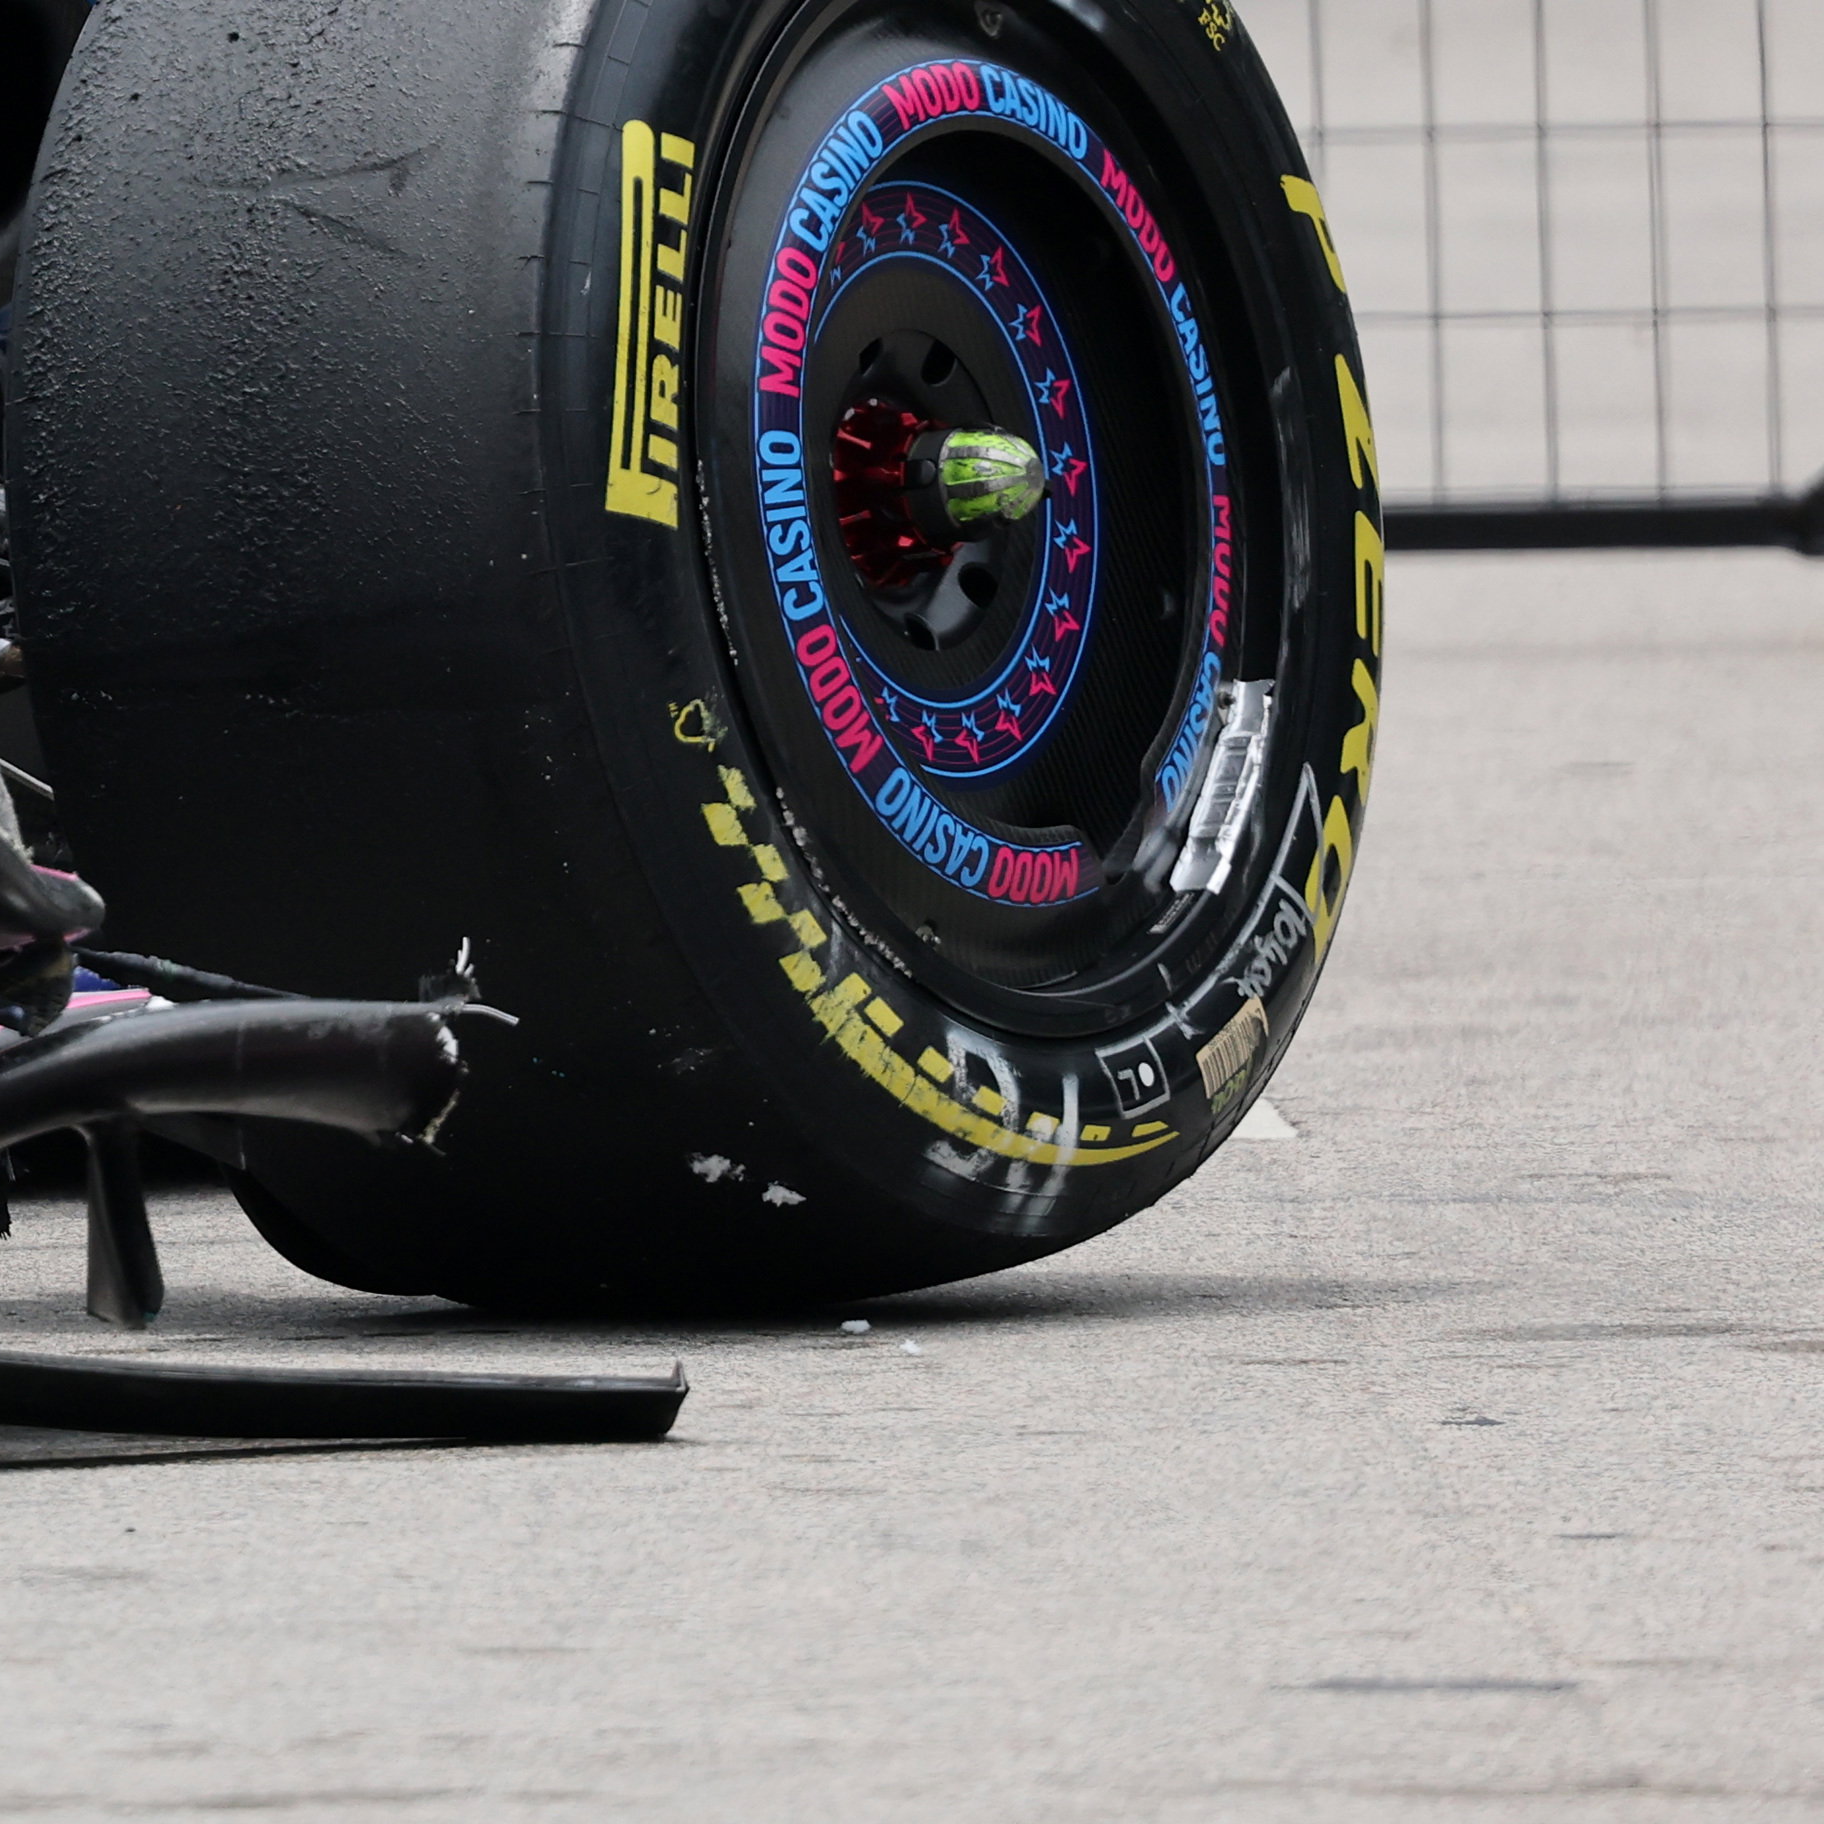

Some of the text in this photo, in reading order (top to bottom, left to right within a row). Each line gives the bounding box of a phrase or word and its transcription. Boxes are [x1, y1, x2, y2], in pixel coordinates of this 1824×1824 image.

[758, 108, 885, 399] MODO CASINO
[882, 62, 1089, 161] MODO CASINO
[605, 120, 695, 528] PIRELLI
[1099, 148, 1227, 468] MODO CASINO
[760, 429, 884, 774] MODO CASINO
[1159, 651, 1222, 814] CASINO
[874, 766, 1080, 904] MODO CASINO
